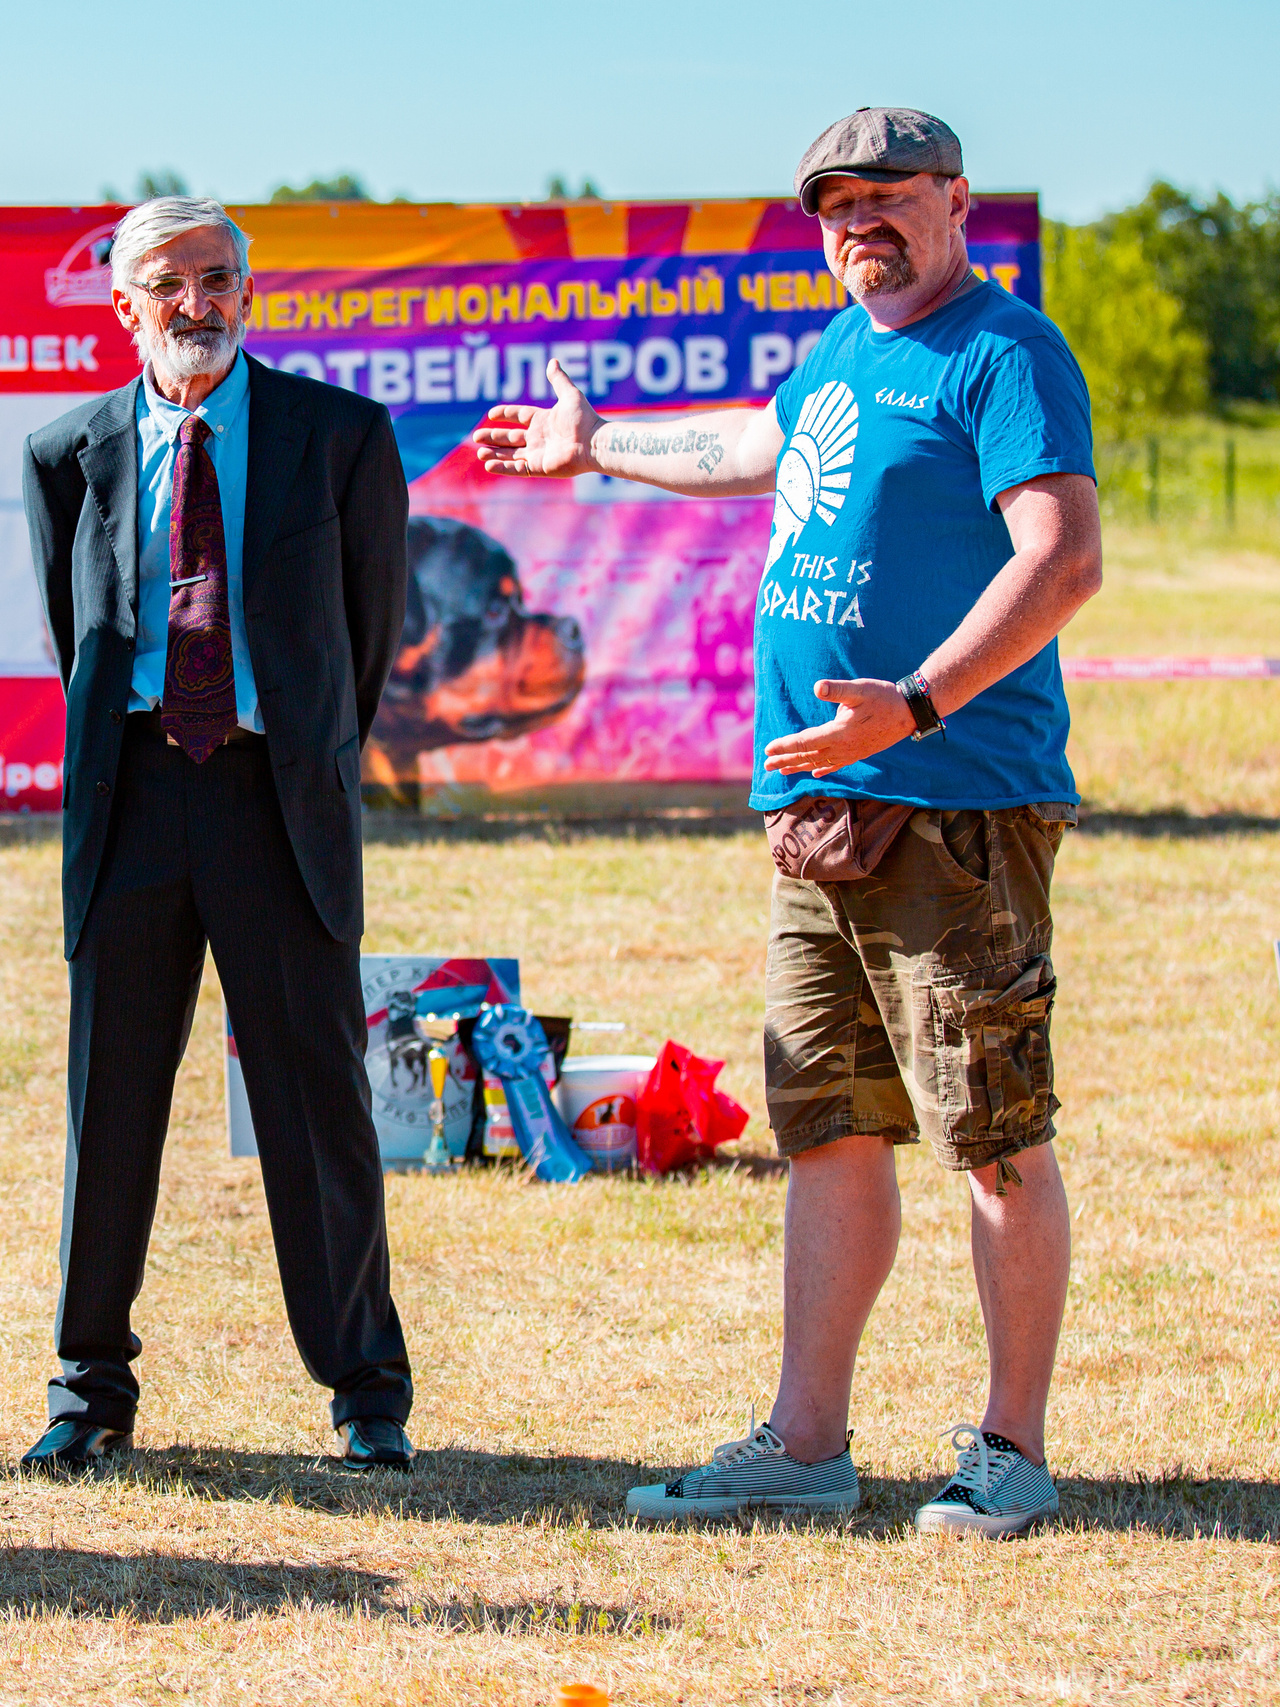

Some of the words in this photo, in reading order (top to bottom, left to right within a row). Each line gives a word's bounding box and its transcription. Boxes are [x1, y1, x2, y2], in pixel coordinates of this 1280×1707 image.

[790, 553, 839, 582] THIS
[846, 559, 873, 585] IS
[760, 580, 865, 629] SPARTA
